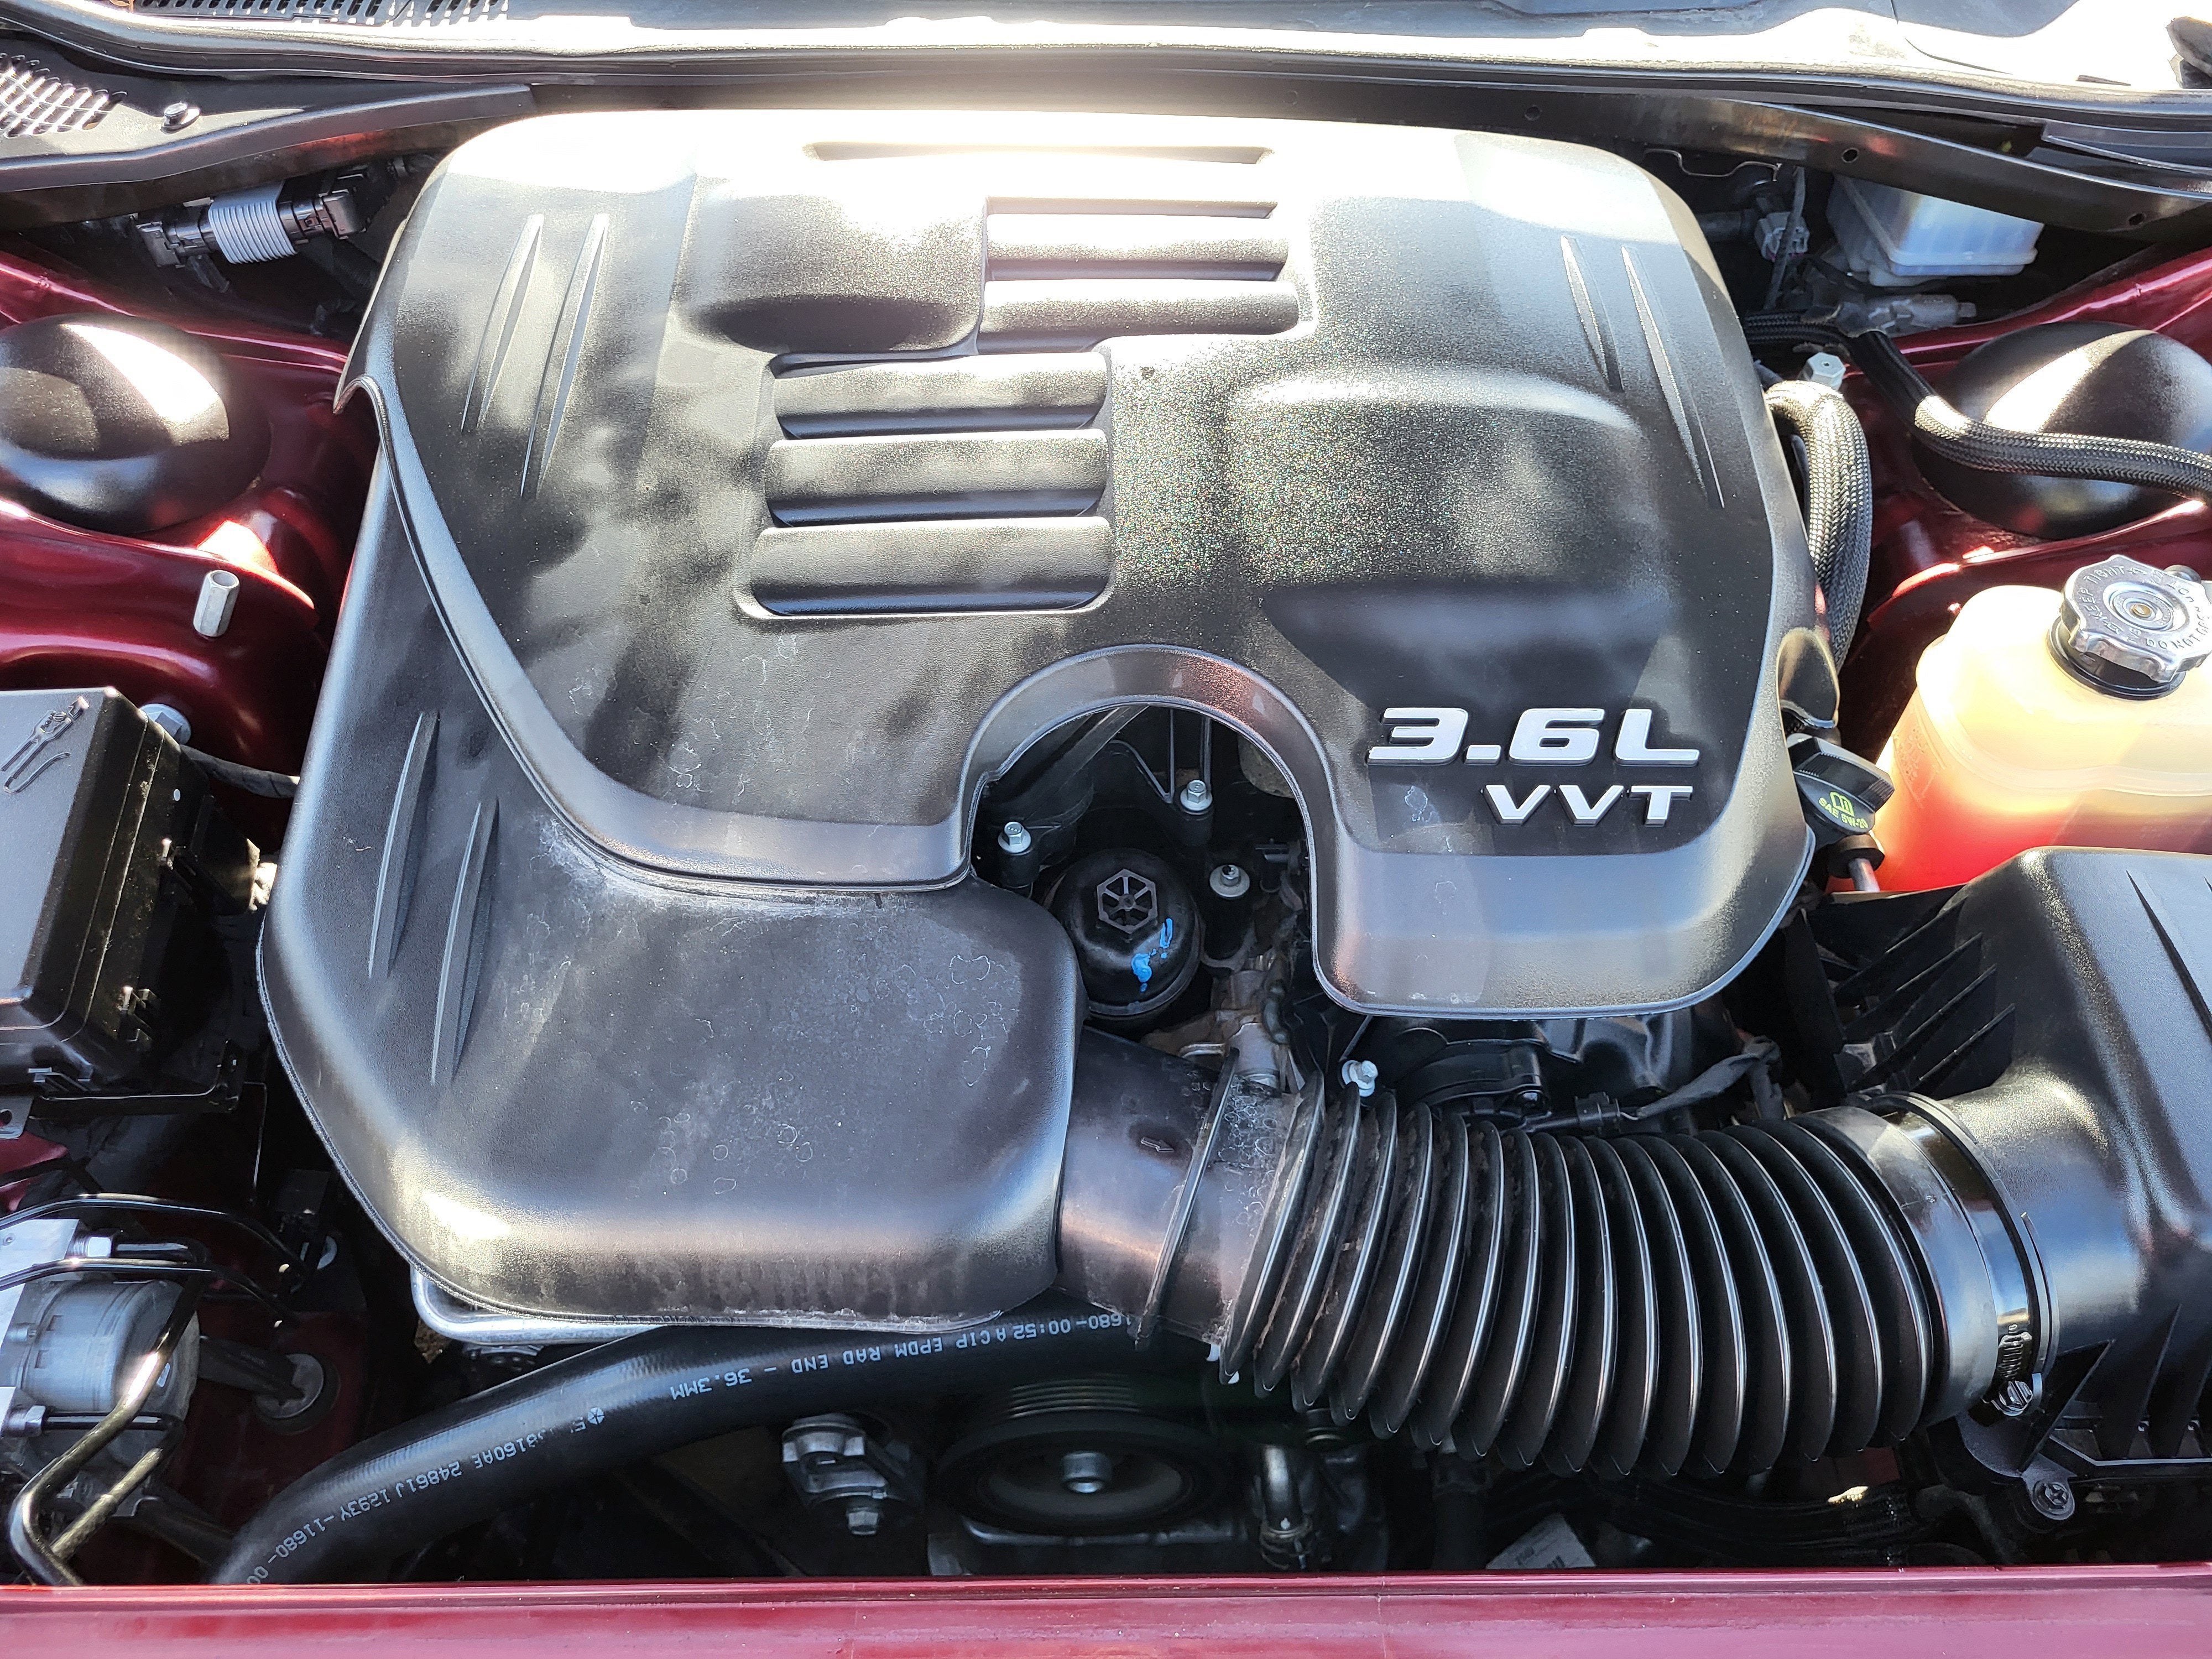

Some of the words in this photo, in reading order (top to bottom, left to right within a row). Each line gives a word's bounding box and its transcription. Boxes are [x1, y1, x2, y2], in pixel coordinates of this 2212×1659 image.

[1366, 707, 1700, 766] 3.6L
[1481, 785, 1694, 826] VVT
[1818, 797, 1839, 818] SAE
[1841, 813, 1868, 828] 5W-20
[894, 1336, 943, 1359] EPDM
[955, 1328, 990, 1349] CIP
[790, 1354, 828, 1375] END
[842, 1345, 881, 1366] RAD
[670, 1366, 752, 1401] 36.3MM
